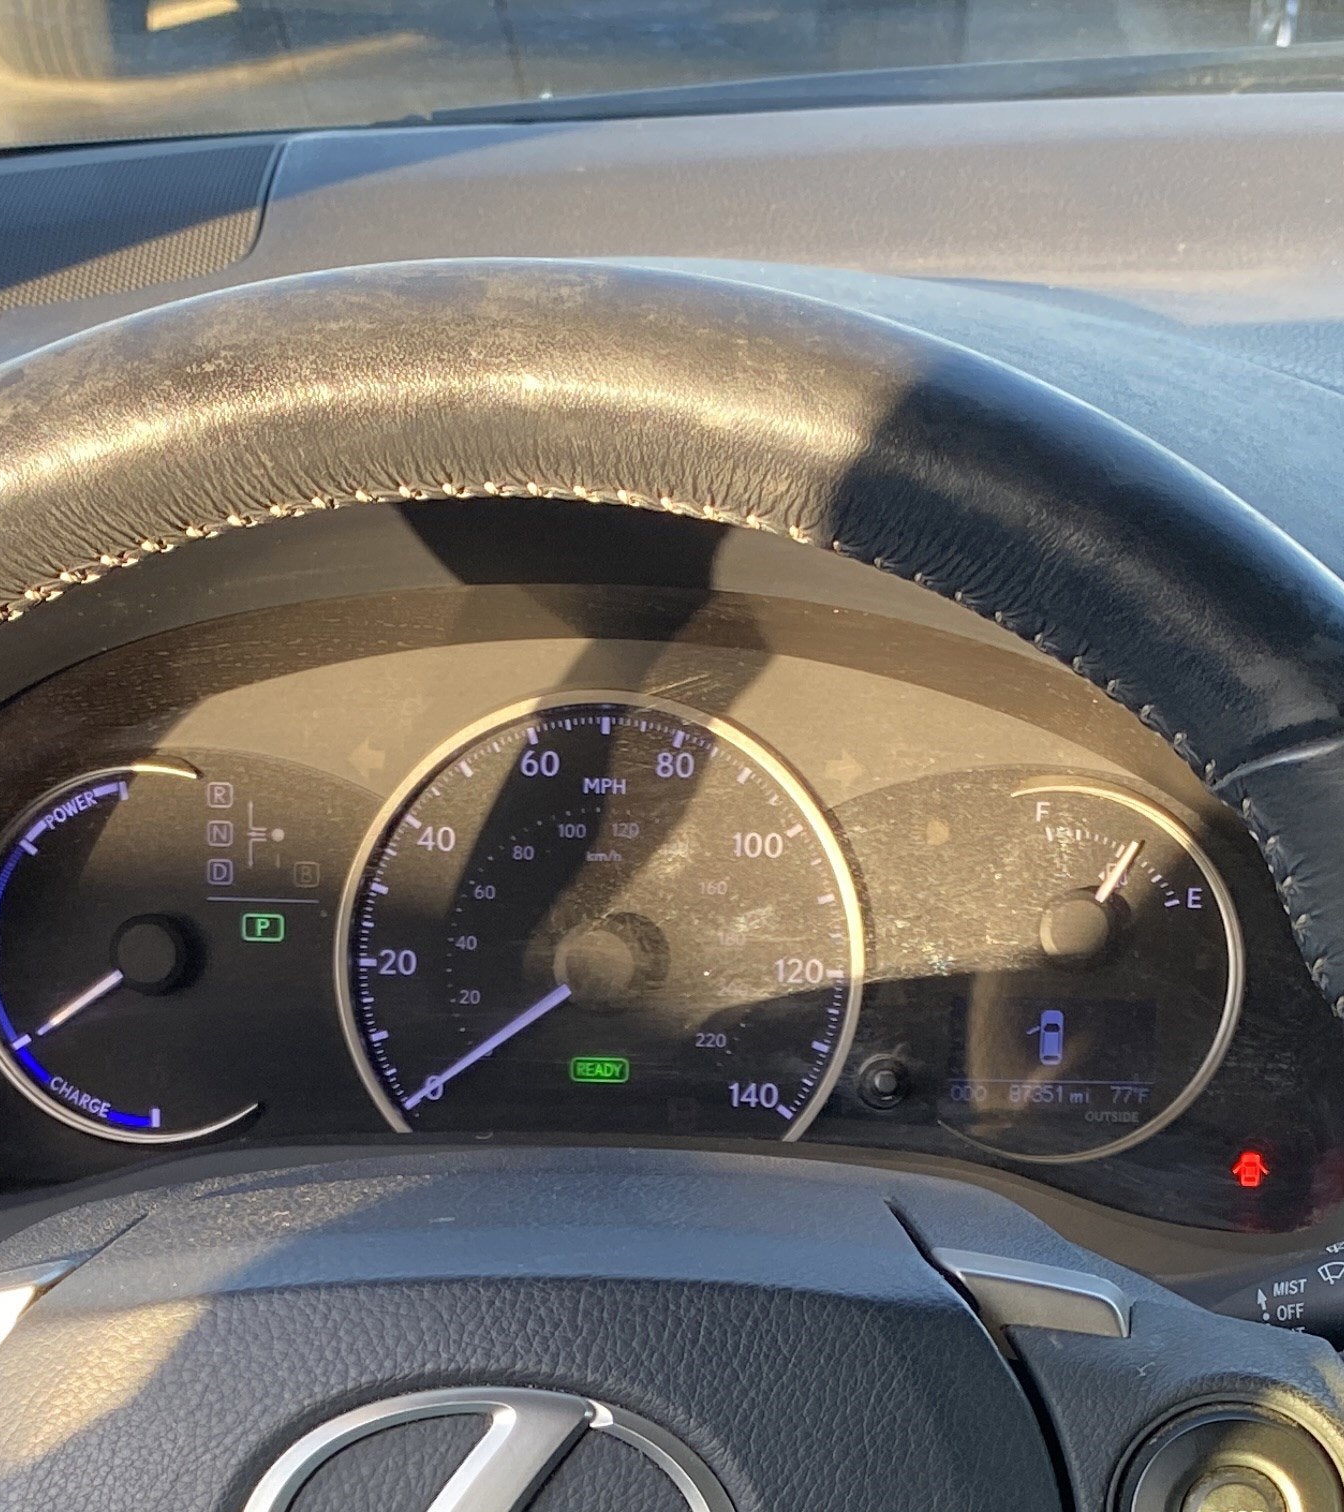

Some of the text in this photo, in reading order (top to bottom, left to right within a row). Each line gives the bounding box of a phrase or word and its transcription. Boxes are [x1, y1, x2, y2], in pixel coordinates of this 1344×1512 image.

[520, 750, 560, 778] 60
[656, 752, 695, 779] 80
[214, 787, 226, 803] R
[583, 778, 626, 796] MPH
[44, 791, 97, 830] POWER
[1036, 802, 1051, 822] F
[213, 826, 227, 841] N
[418, 826, 456, 851] 40
[558, 823, 586, 838] 100
[512, 845, 534, 862] 80
[732, 833, 783, 859] 100
[213, 865, 227, 882] D
[474, 884, 496, 900] 60
[1187, 888, 1203, 908] E
[255, 919, 270, 935] P
[456, 935, 477, 951] 40
[379, 949, 417, 975] 20
[775, 960, 824, 984] 120
[460, 990, 481, 1004] 20
[695, 1033, 726, 1047] 220
[576, 1062, 623, 1077] READY
[50, 1076, 111, 1118] CHARGE
[729, 1083, 779, 1109] 140
[1085, 1111, 1139, 1123] OUTSIDE
[1273, 1278, 1308, 1297] MIST
[1276, 1302, 1304, 1321] OFF
